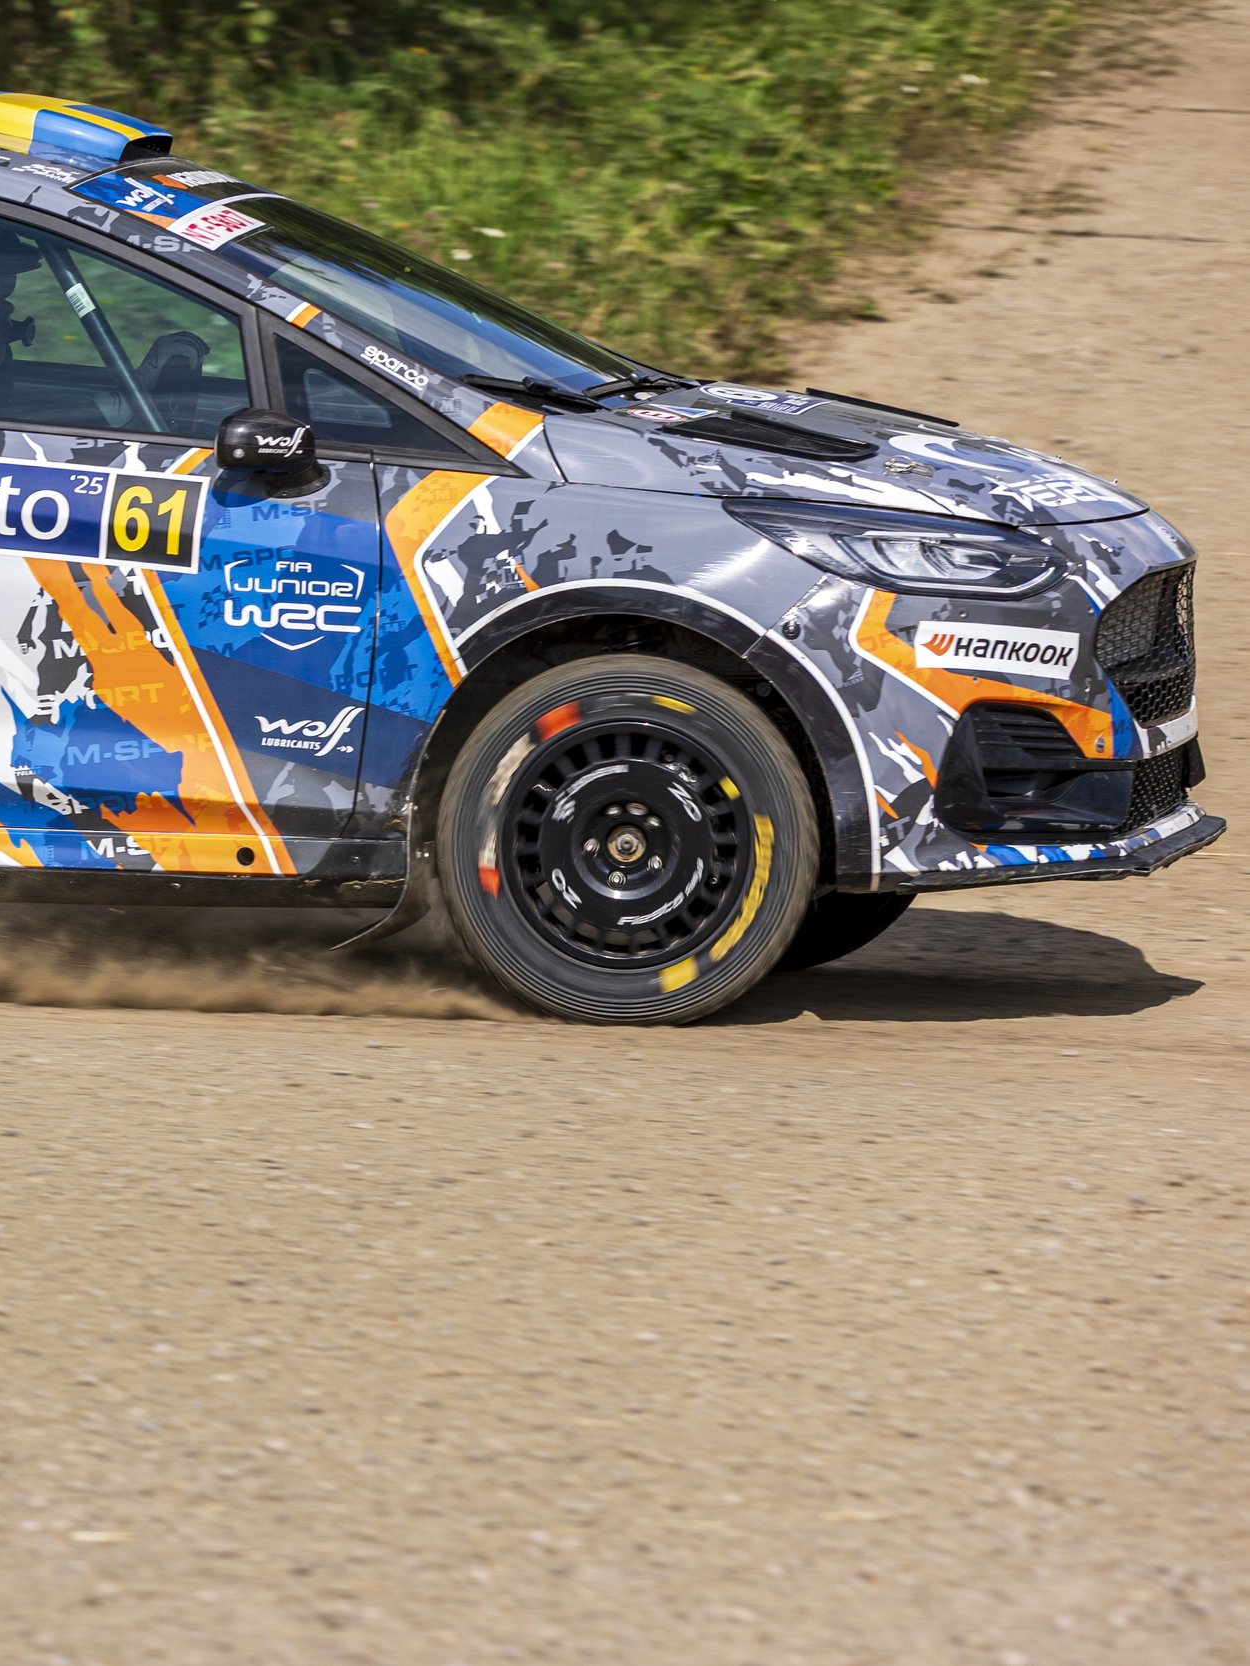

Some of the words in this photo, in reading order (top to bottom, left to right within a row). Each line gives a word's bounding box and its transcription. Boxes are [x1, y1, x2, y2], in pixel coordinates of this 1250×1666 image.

[360, 345, 429, 391] sparco
[70, 474, 104, 496] '25
[112, 485, 188, 556] 61
[276, 561, 312, 573] FIA
[234, 577, 353, 598] JUNIOR
[224, 600, 362, 633] WRC
[254, 706, 365, 757] wolf
[261, 737, 321, 751] LUBRICANTS
